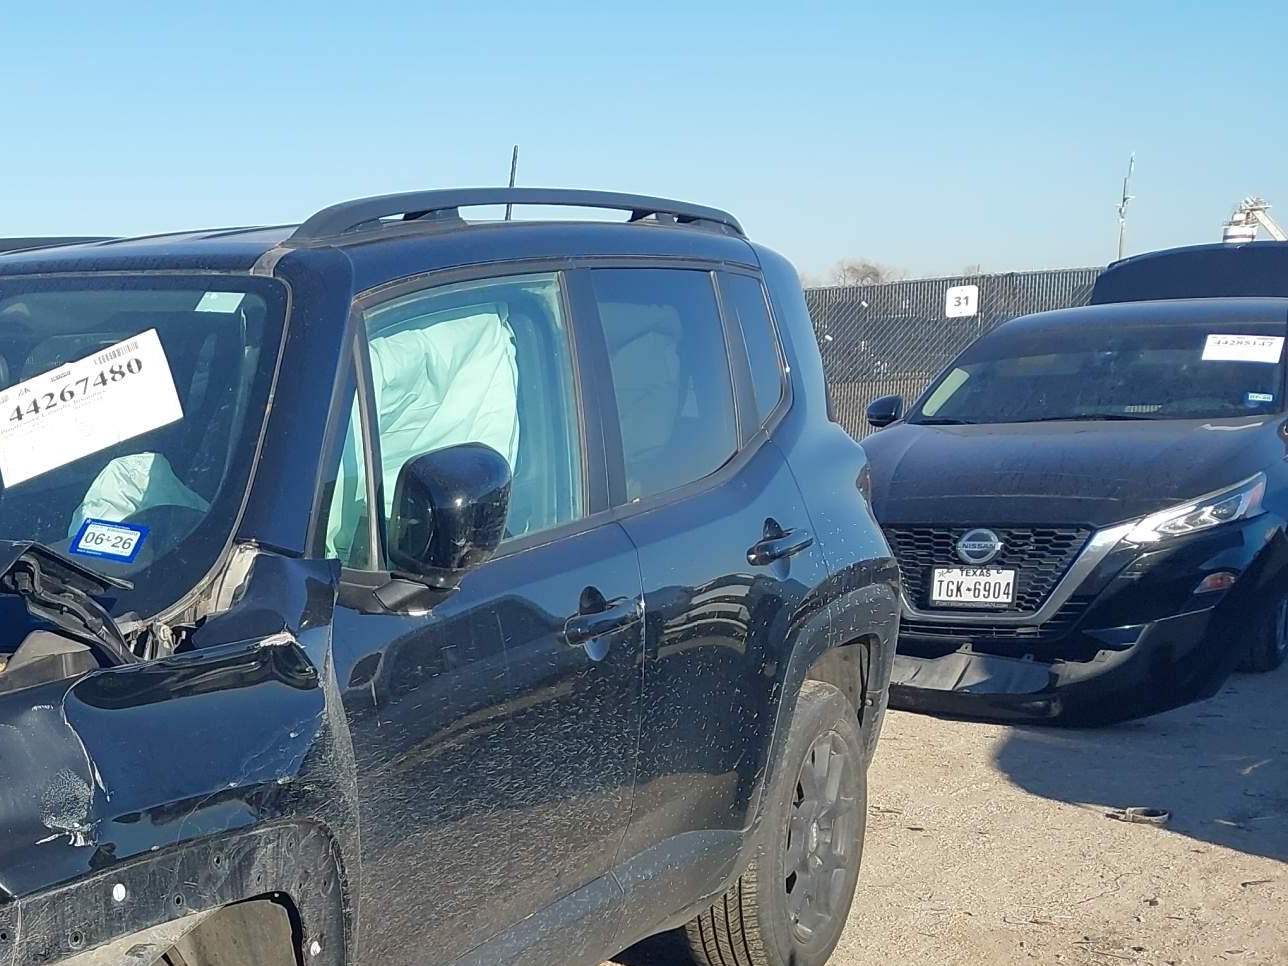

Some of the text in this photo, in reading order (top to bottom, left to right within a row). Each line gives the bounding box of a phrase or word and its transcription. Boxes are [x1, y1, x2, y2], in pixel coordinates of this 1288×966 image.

[953, 295, 969, 307] 31
[8, 357, 143, 422] 44267480
[962, 542, 996, 550] NISSAN
[959, 568, 992, 578] TEXAS
